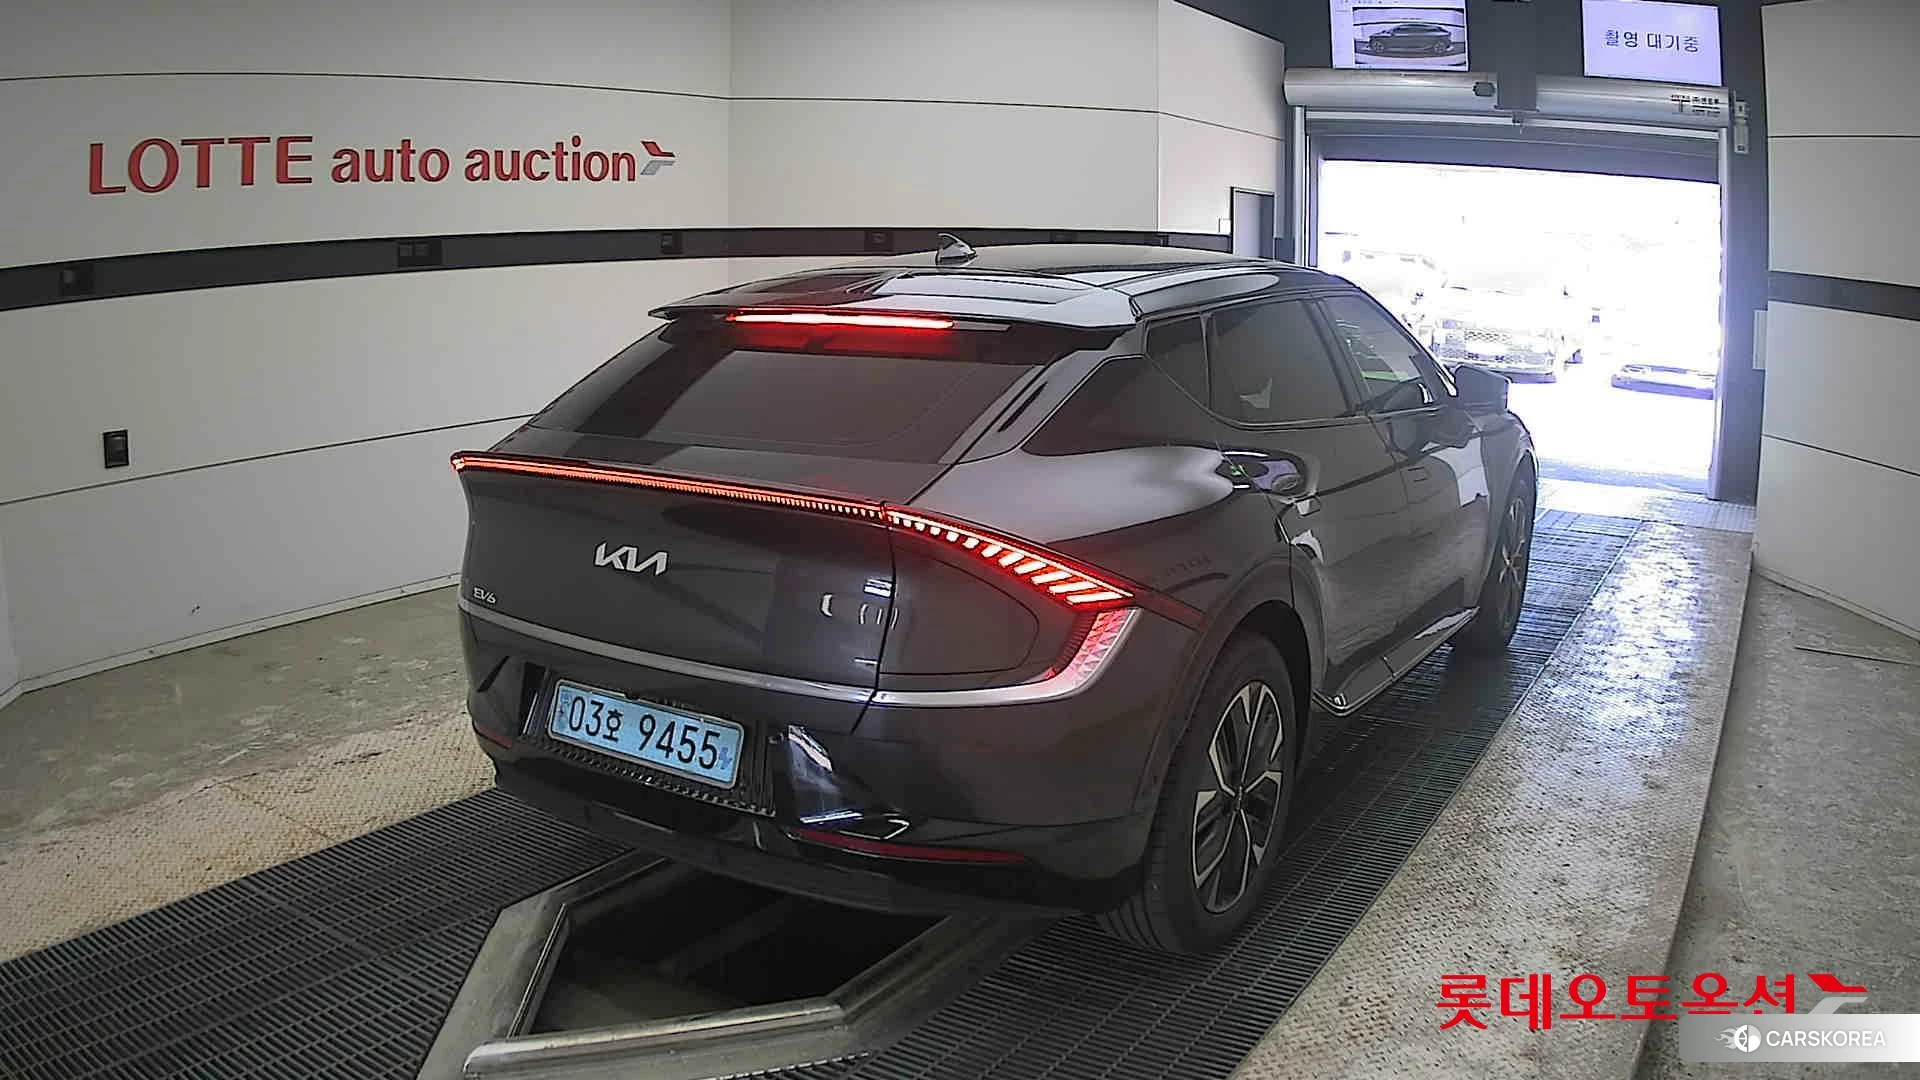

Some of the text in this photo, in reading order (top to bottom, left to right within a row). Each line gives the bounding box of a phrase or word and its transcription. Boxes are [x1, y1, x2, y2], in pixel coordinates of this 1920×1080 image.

[1647, 32, 1699, 53] 대기중
[89, 135, 636, 194] LOTTE auto auction
[473, 587, 497, 604] EV6
[568, 696, 721, 770] 03호 9455
